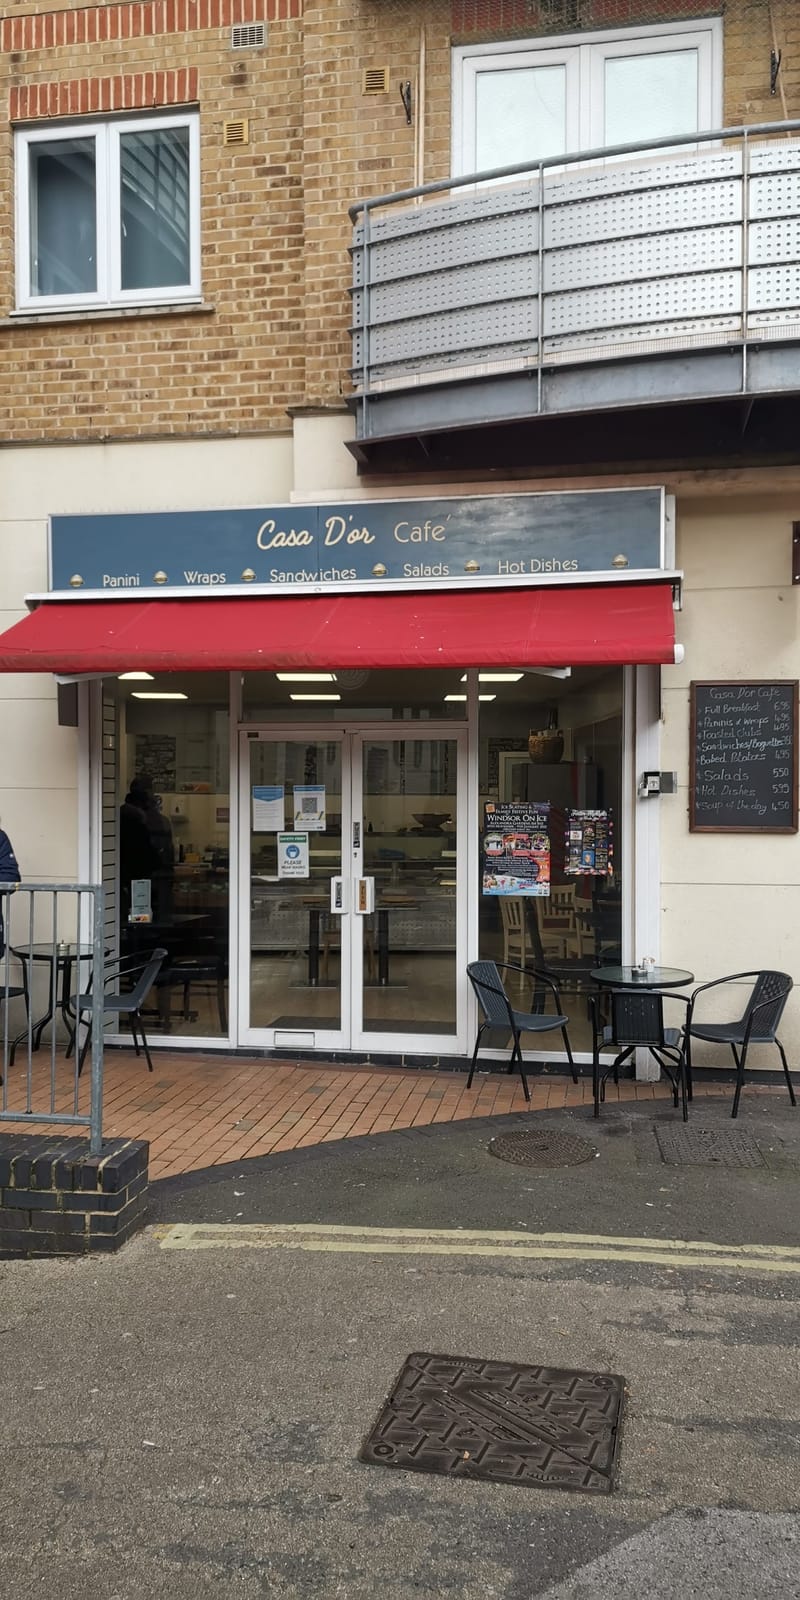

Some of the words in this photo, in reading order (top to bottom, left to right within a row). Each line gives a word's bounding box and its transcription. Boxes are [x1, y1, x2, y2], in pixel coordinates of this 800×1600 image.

[256, 519, 313, 550] Casa
[324, 514, 376, 546] D'or
[103, 573, 140, 588] Panini
[183, 570, 226, 586] Wraps
[269, 567, 357, 583] Sandwiches
[403, 562, 450, 577] Salads
[498, 559, 526, 574] Hot
[530, 557, 579, 573] Dishes
[709, 687, 735, 699] Casa
[704, 705, 721, 714] Full
[723, 701, 760, 713] Breakfast
[703, 728, 735, 740] Toasted
[700, 752, 727, 766] Baked
[704, 768, 750, 782] Salads
[701, 784, 717, 796] Hot
[720, 784, 757, 797] Dishes
[750, 799, 768, 816] day
[487, 814, 521, 822] WINDSOR
[536, 814, 548, 822] ICE
